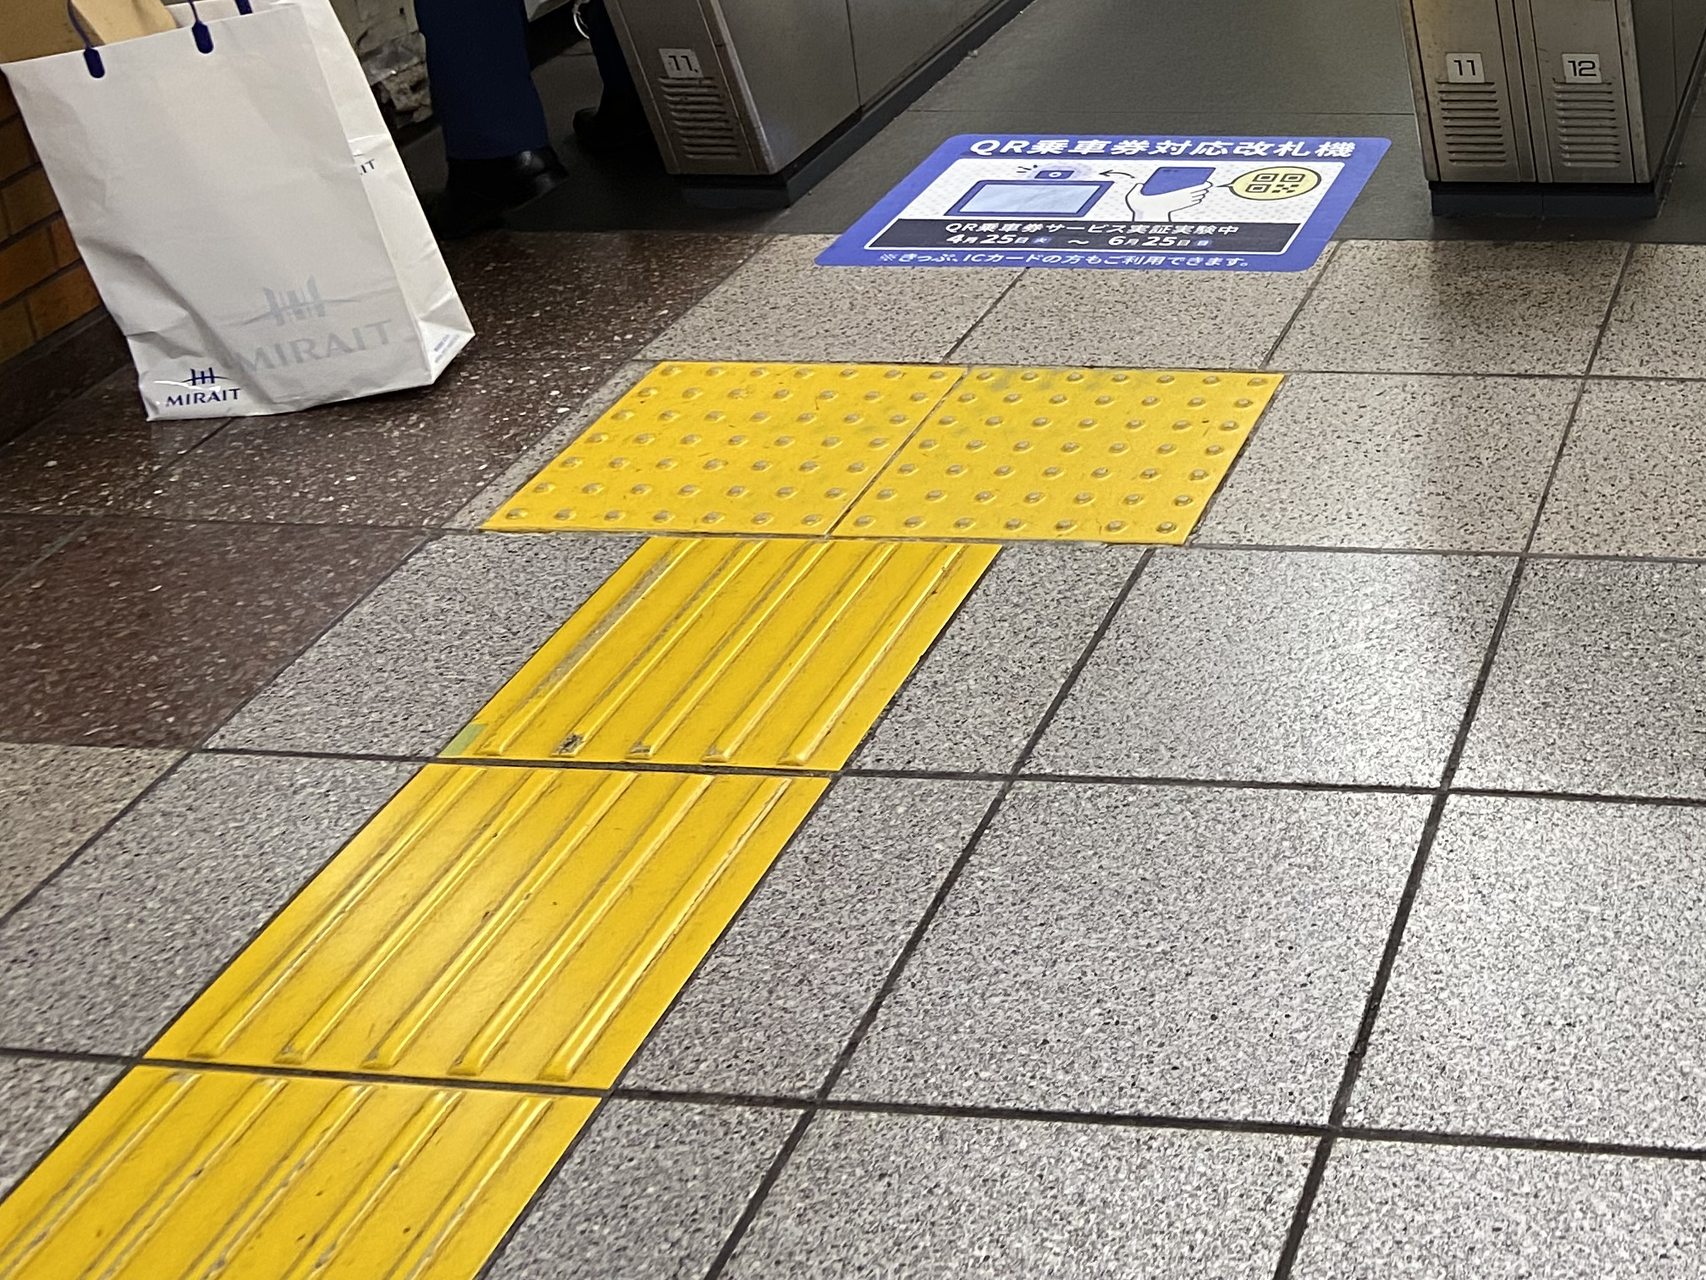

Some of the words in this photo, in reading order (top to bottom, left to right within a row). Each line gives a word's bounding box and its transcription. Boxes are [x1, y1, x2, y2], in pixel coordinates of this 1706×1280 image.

[1454, 60, 1476, 76] 11
[1568, 60, 1596, 77] 12
[969, 138, 1356, 159] QR乗車券対応改札機
[233, 319, 394, 374] MIRAIT
[165, 387, 241, 407] MIRAIT
